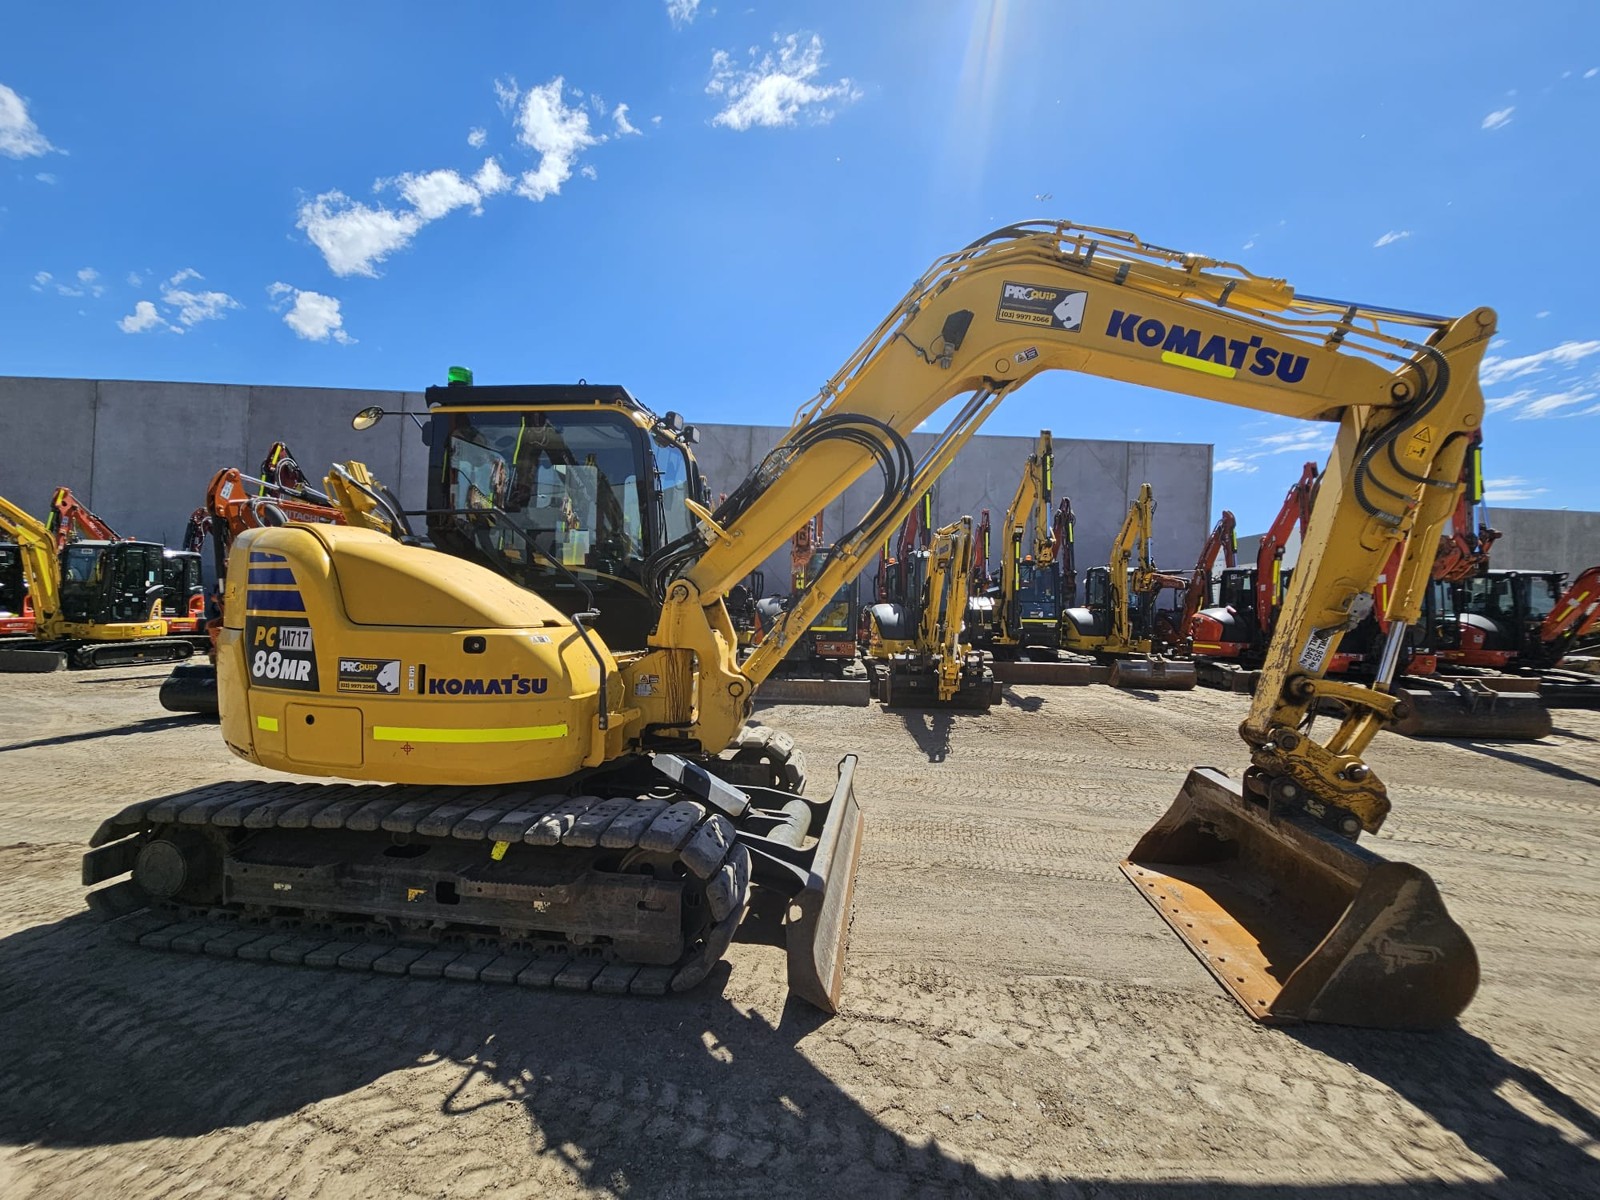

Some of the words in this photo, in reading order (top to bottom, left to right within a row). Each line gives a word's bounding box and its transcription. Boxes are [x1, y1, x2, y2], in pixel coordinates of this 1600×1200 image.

[1001, 311, 1014, 319] (03)
[1015, 313, 1031, 321] 9971
[1032, 315, 1050, 323] 2066
[1105, 309, 1310, 384] KOMATSU
[254, 626, 277, 647] PC
[282, 630, 309, 648] M717
[252, 650, 311, 681] 88MR
[429, 674, 548, 695] KOMATSU
